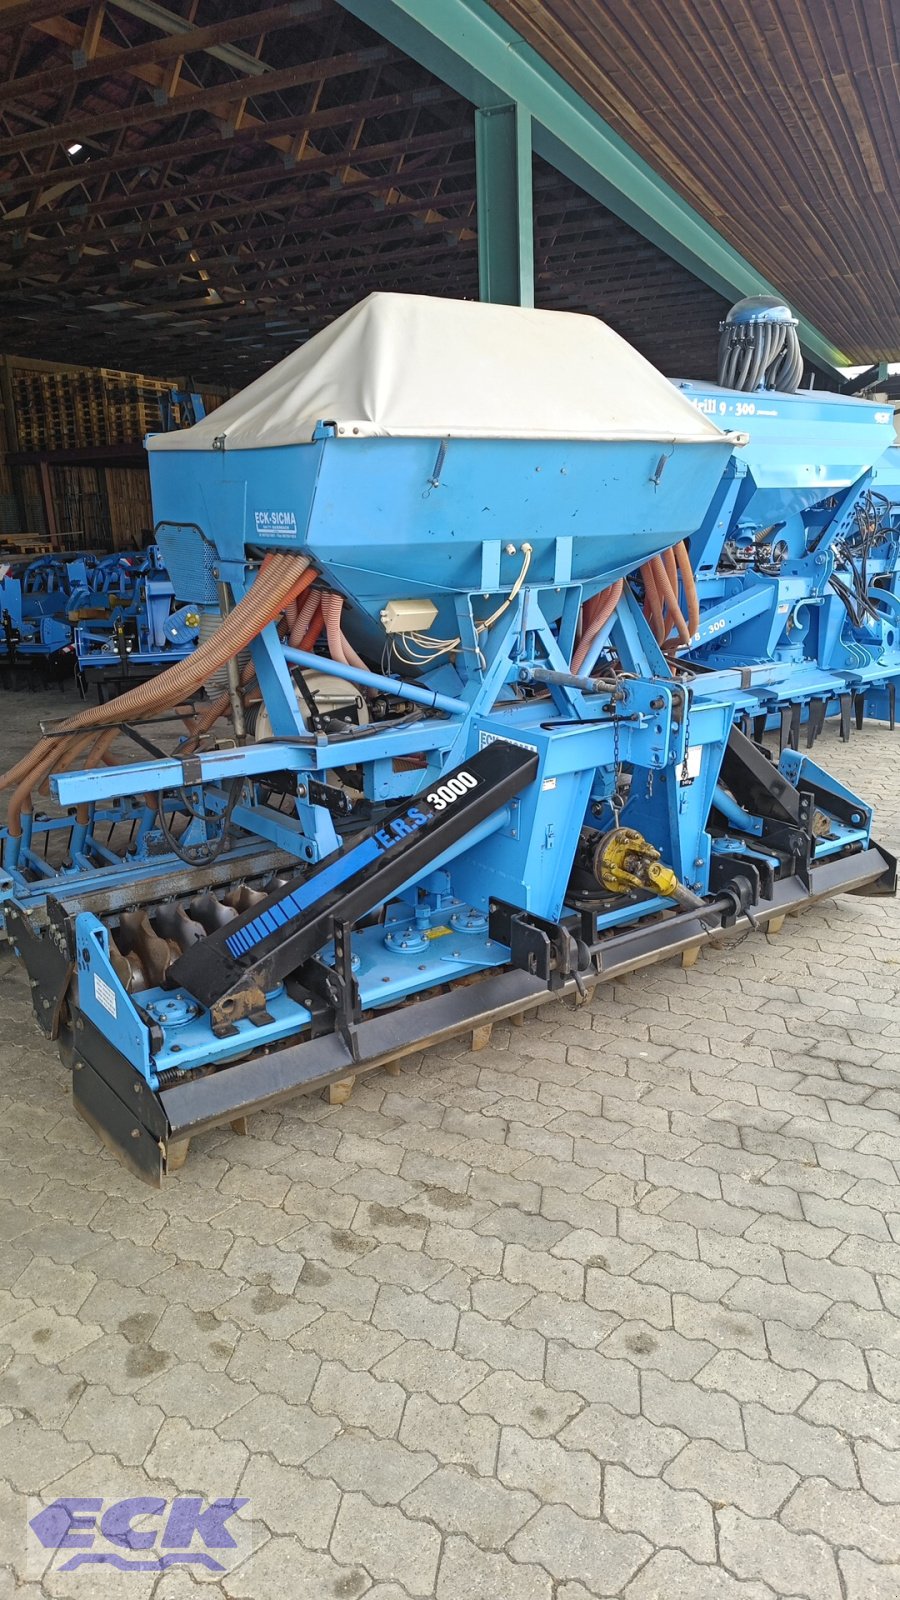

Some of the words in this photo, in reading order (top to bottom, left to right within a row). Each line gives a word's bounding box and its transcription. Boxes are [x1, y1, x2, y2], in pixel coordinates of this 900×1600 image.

[719, 402, 727, 416] 9
[735, 403, 756, 417] 300
[708, 619, 726, 633] 300
[375, 807, 434, 849] E.R.S.
[426, 771, 478, 810] 3000
